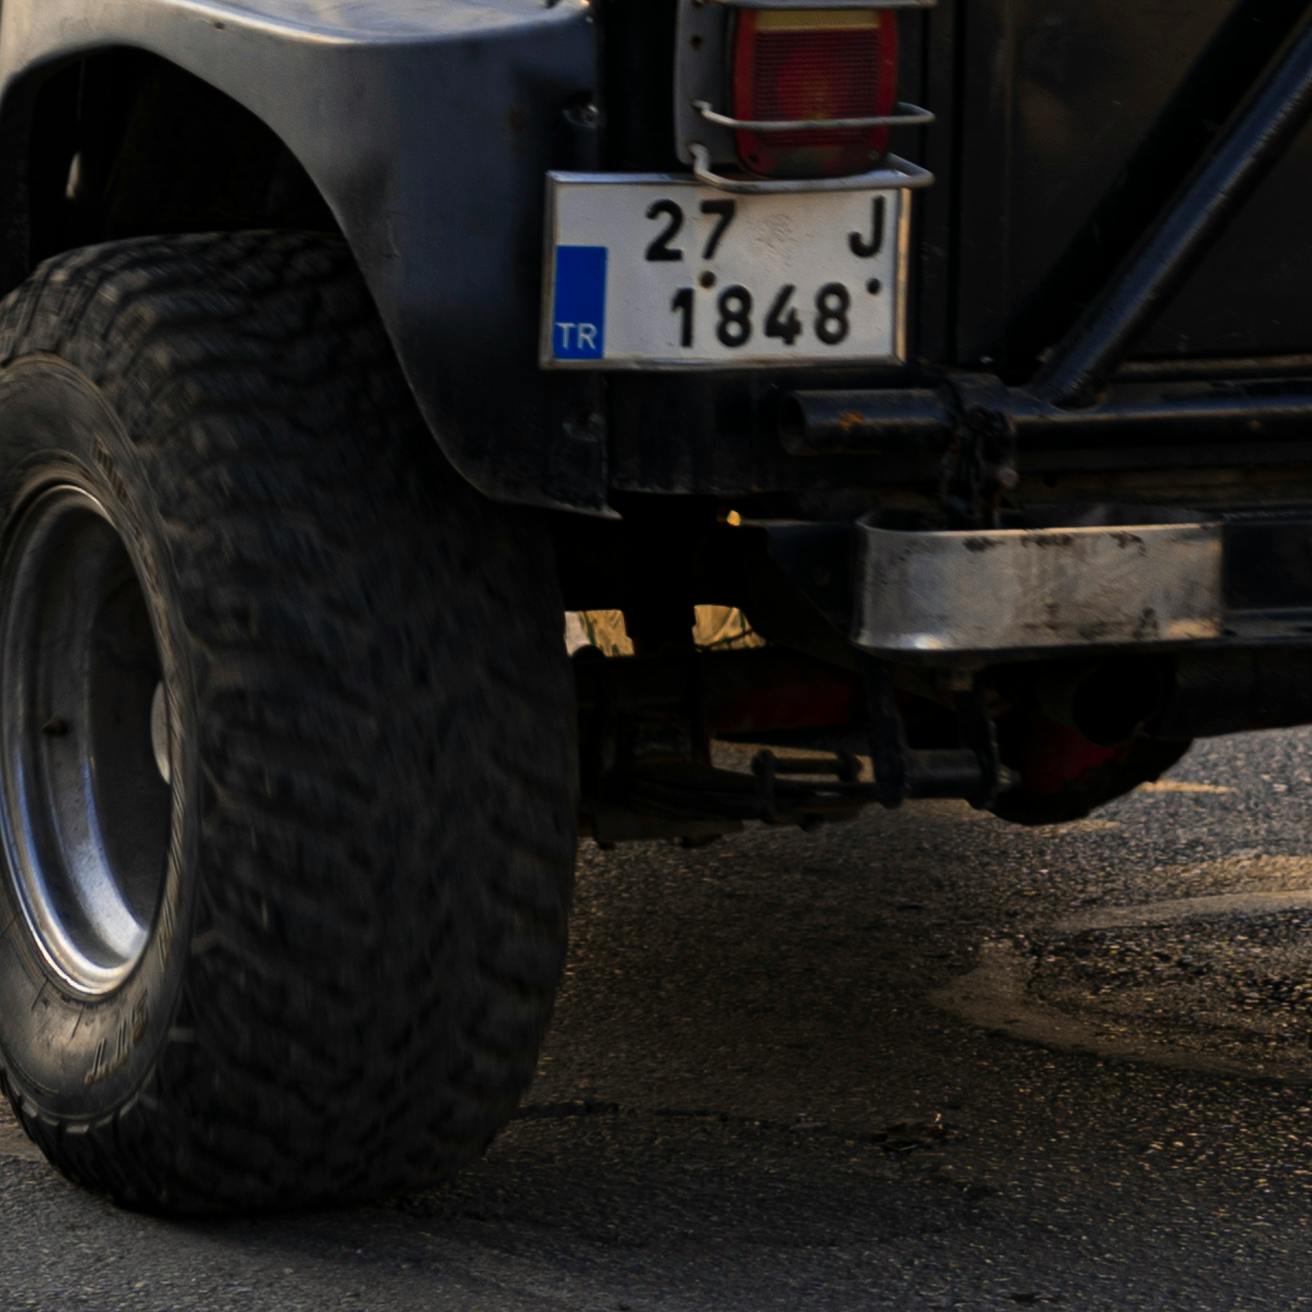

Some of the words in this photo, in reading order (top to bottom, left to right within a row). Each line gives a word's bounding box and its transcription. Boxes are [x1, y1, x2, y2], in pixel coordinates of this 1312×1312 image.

[644, 198, 736, 262] 27
[847, 194, 887, 259] J
[556, 321, 599, 351] TR
[670, 281, 852, 348] 1848
